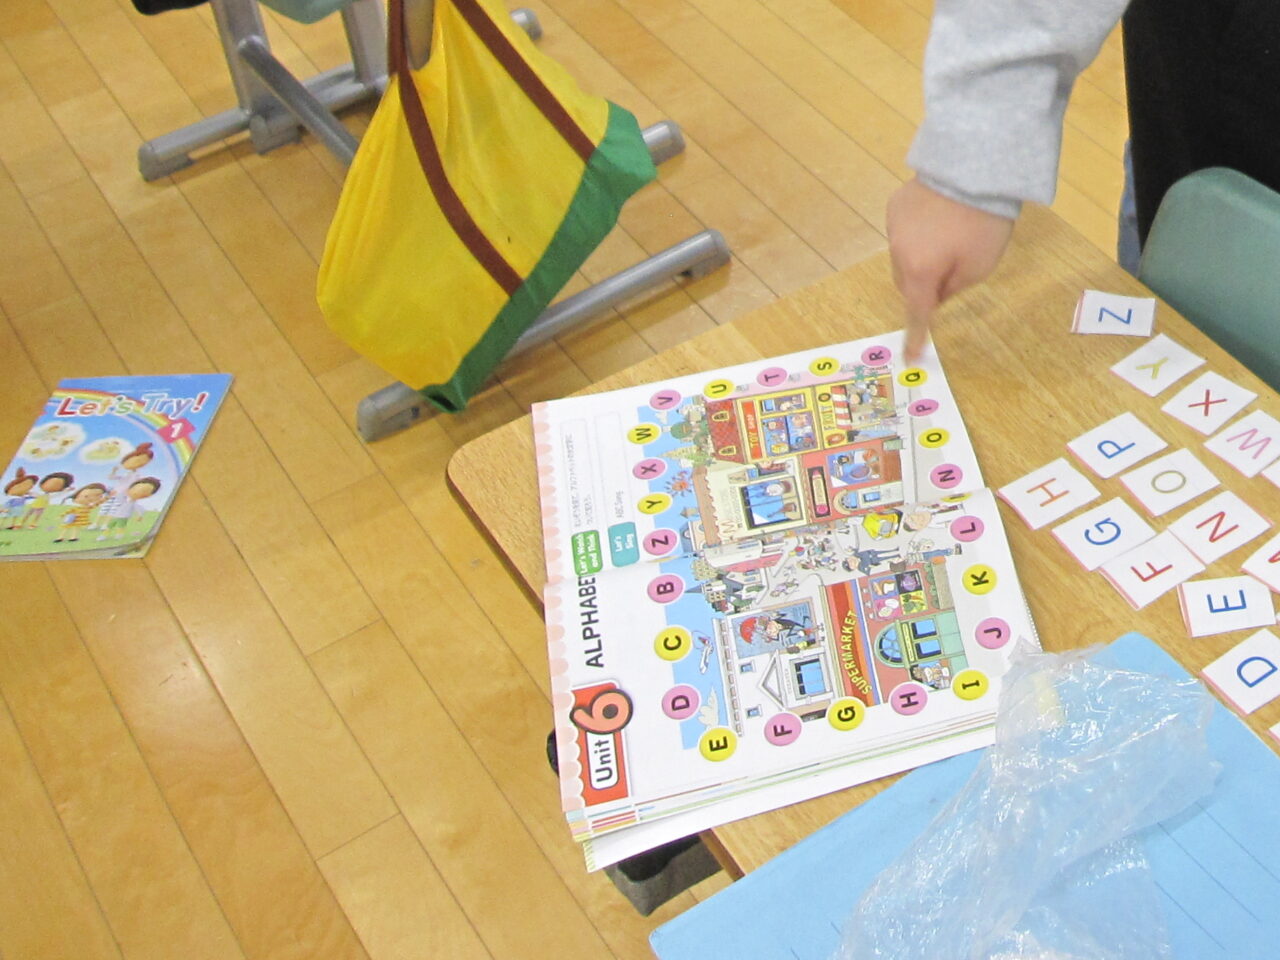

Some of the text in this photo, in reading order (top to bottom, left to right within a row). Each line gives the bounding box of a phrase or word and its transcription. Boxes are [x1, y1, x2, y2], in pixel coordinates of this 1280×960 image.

[1098, 306, 1133, 324] Z
[1136, 356, 1169, 379] Y
[905, 371, 921, 383] Q
[57, 392, 208, 418] Let's Try!
[1188, 389, 1227, 416] X
[635, 427, 652, 441] W
[1096, 438, 1137, 460] P
[1226, 427, 1272, 460] W
[641, 463, 657, 475] X
[937, 469, 956, 483] N
[1151, 469, 1186, 494] O
[1026, 476, 1069, 507] H
[959, 521, 977, 535] L
[1084, 517, 1122, 546] G
[1196, 511, 1239, 544] N
[651, 535, 669, 548] Z
[970, 570, 990, 587] K
[1131, 561, 1173, 584] F
[656, 581, 675, 596] B
[1206, 590, 1248, 614] E
[578, 575, 604, 667] ALPHABE
[983, 627, 1002, 639] J
[663, 635, 682, 651] C
[838, 610, 872, 695] SUPERMARKET
[1236, 655, 1279, 688] D
[671, 694, 690, 712] D
[899, 691, 919, 709] H
[837, 706, 856, 723] G
[570, 688, 634, 782] Unit 6
[773, 724, 793, 738] F
[708, 736, 729, 752] E
